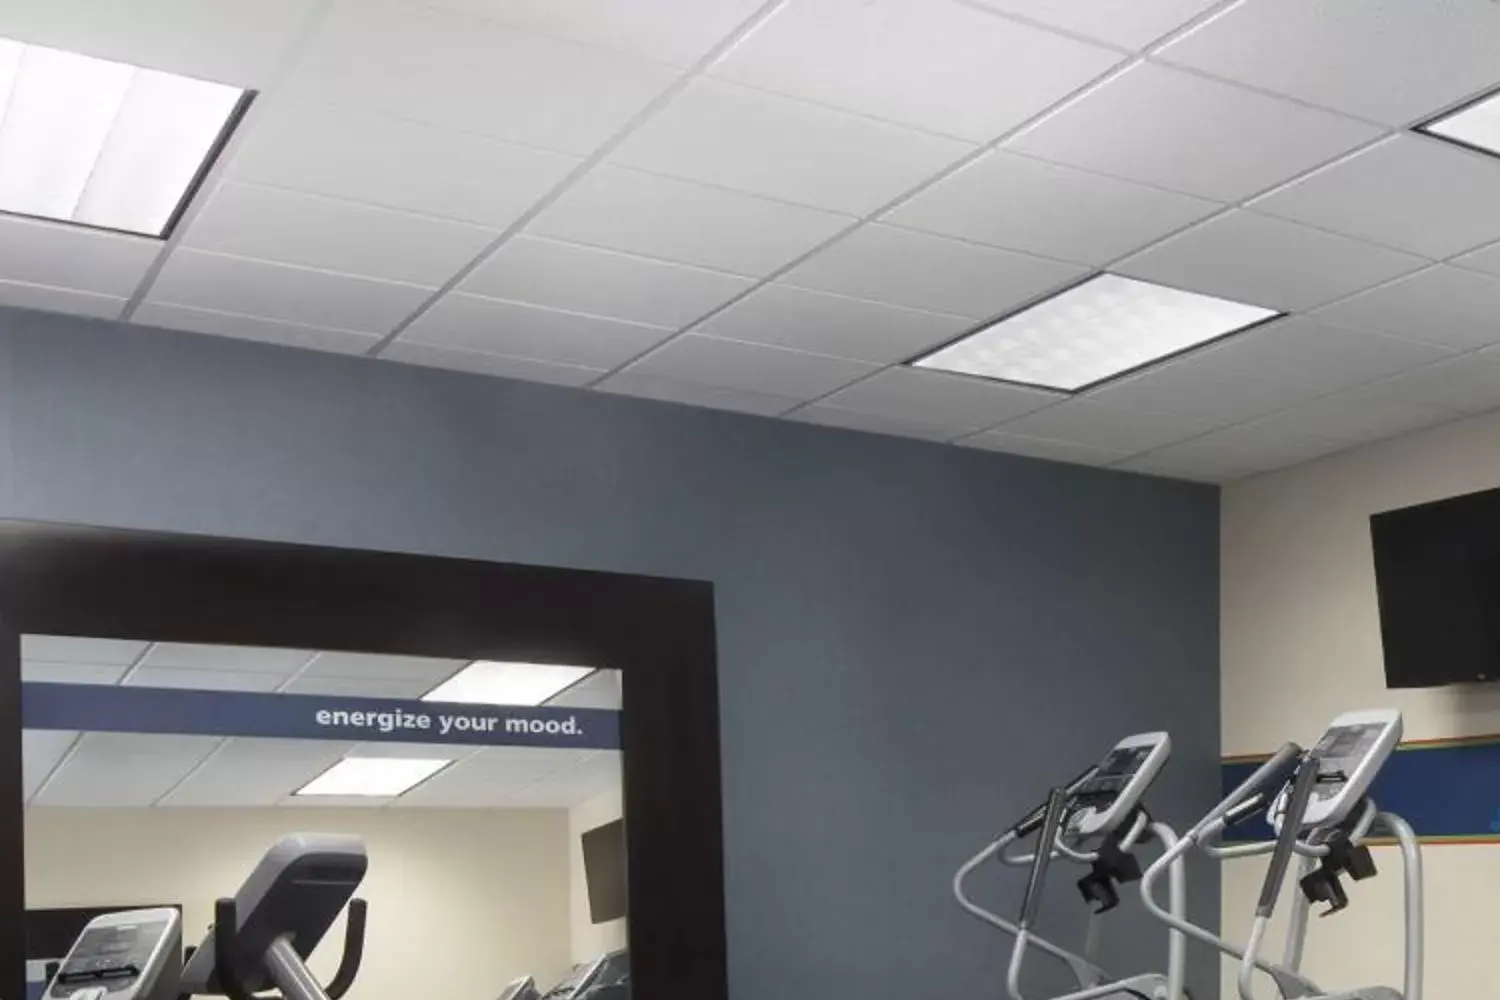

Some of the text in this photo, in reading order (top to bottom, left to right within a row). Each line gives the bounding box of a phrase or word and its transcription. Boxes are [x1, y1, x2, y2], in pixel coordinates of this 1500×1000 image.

[315, 708, 583, 735] energize your mood.
